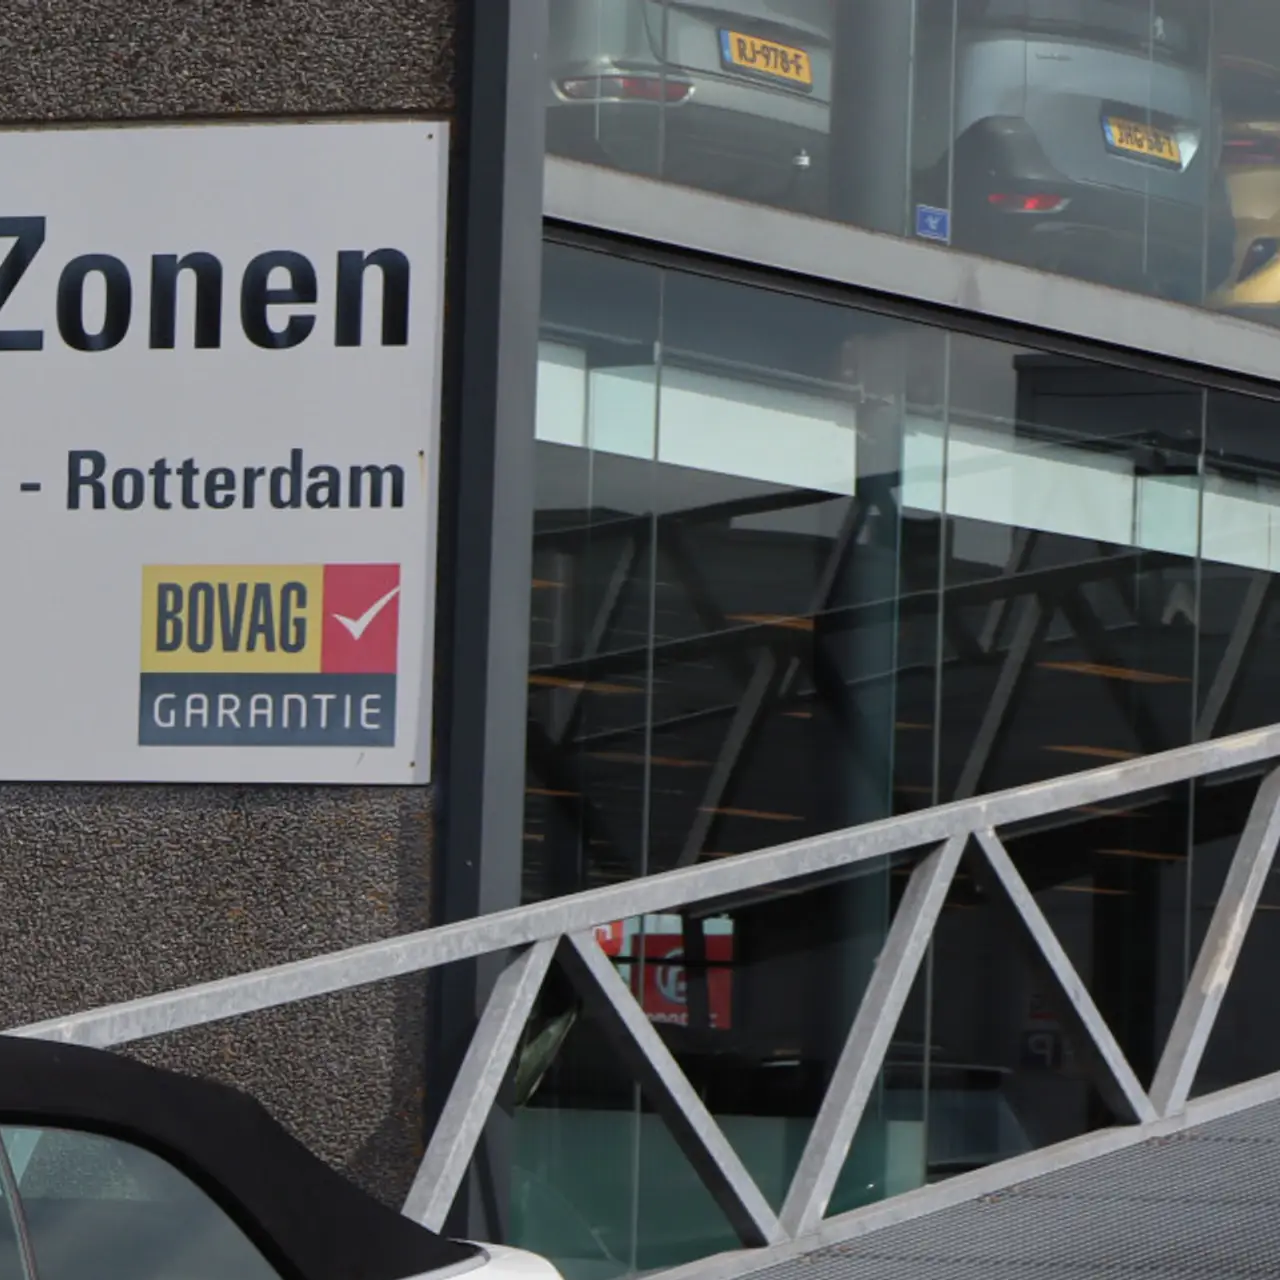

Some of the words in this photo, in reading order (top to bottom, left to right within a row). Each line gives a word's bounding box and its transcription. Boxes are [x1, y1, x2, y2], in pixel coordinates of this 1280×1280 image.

[66, 448, 405, 512] Rotterdam
[155, 582, 308, 654] BOVAG
[153, 693, 382, 730] GARANTIE
